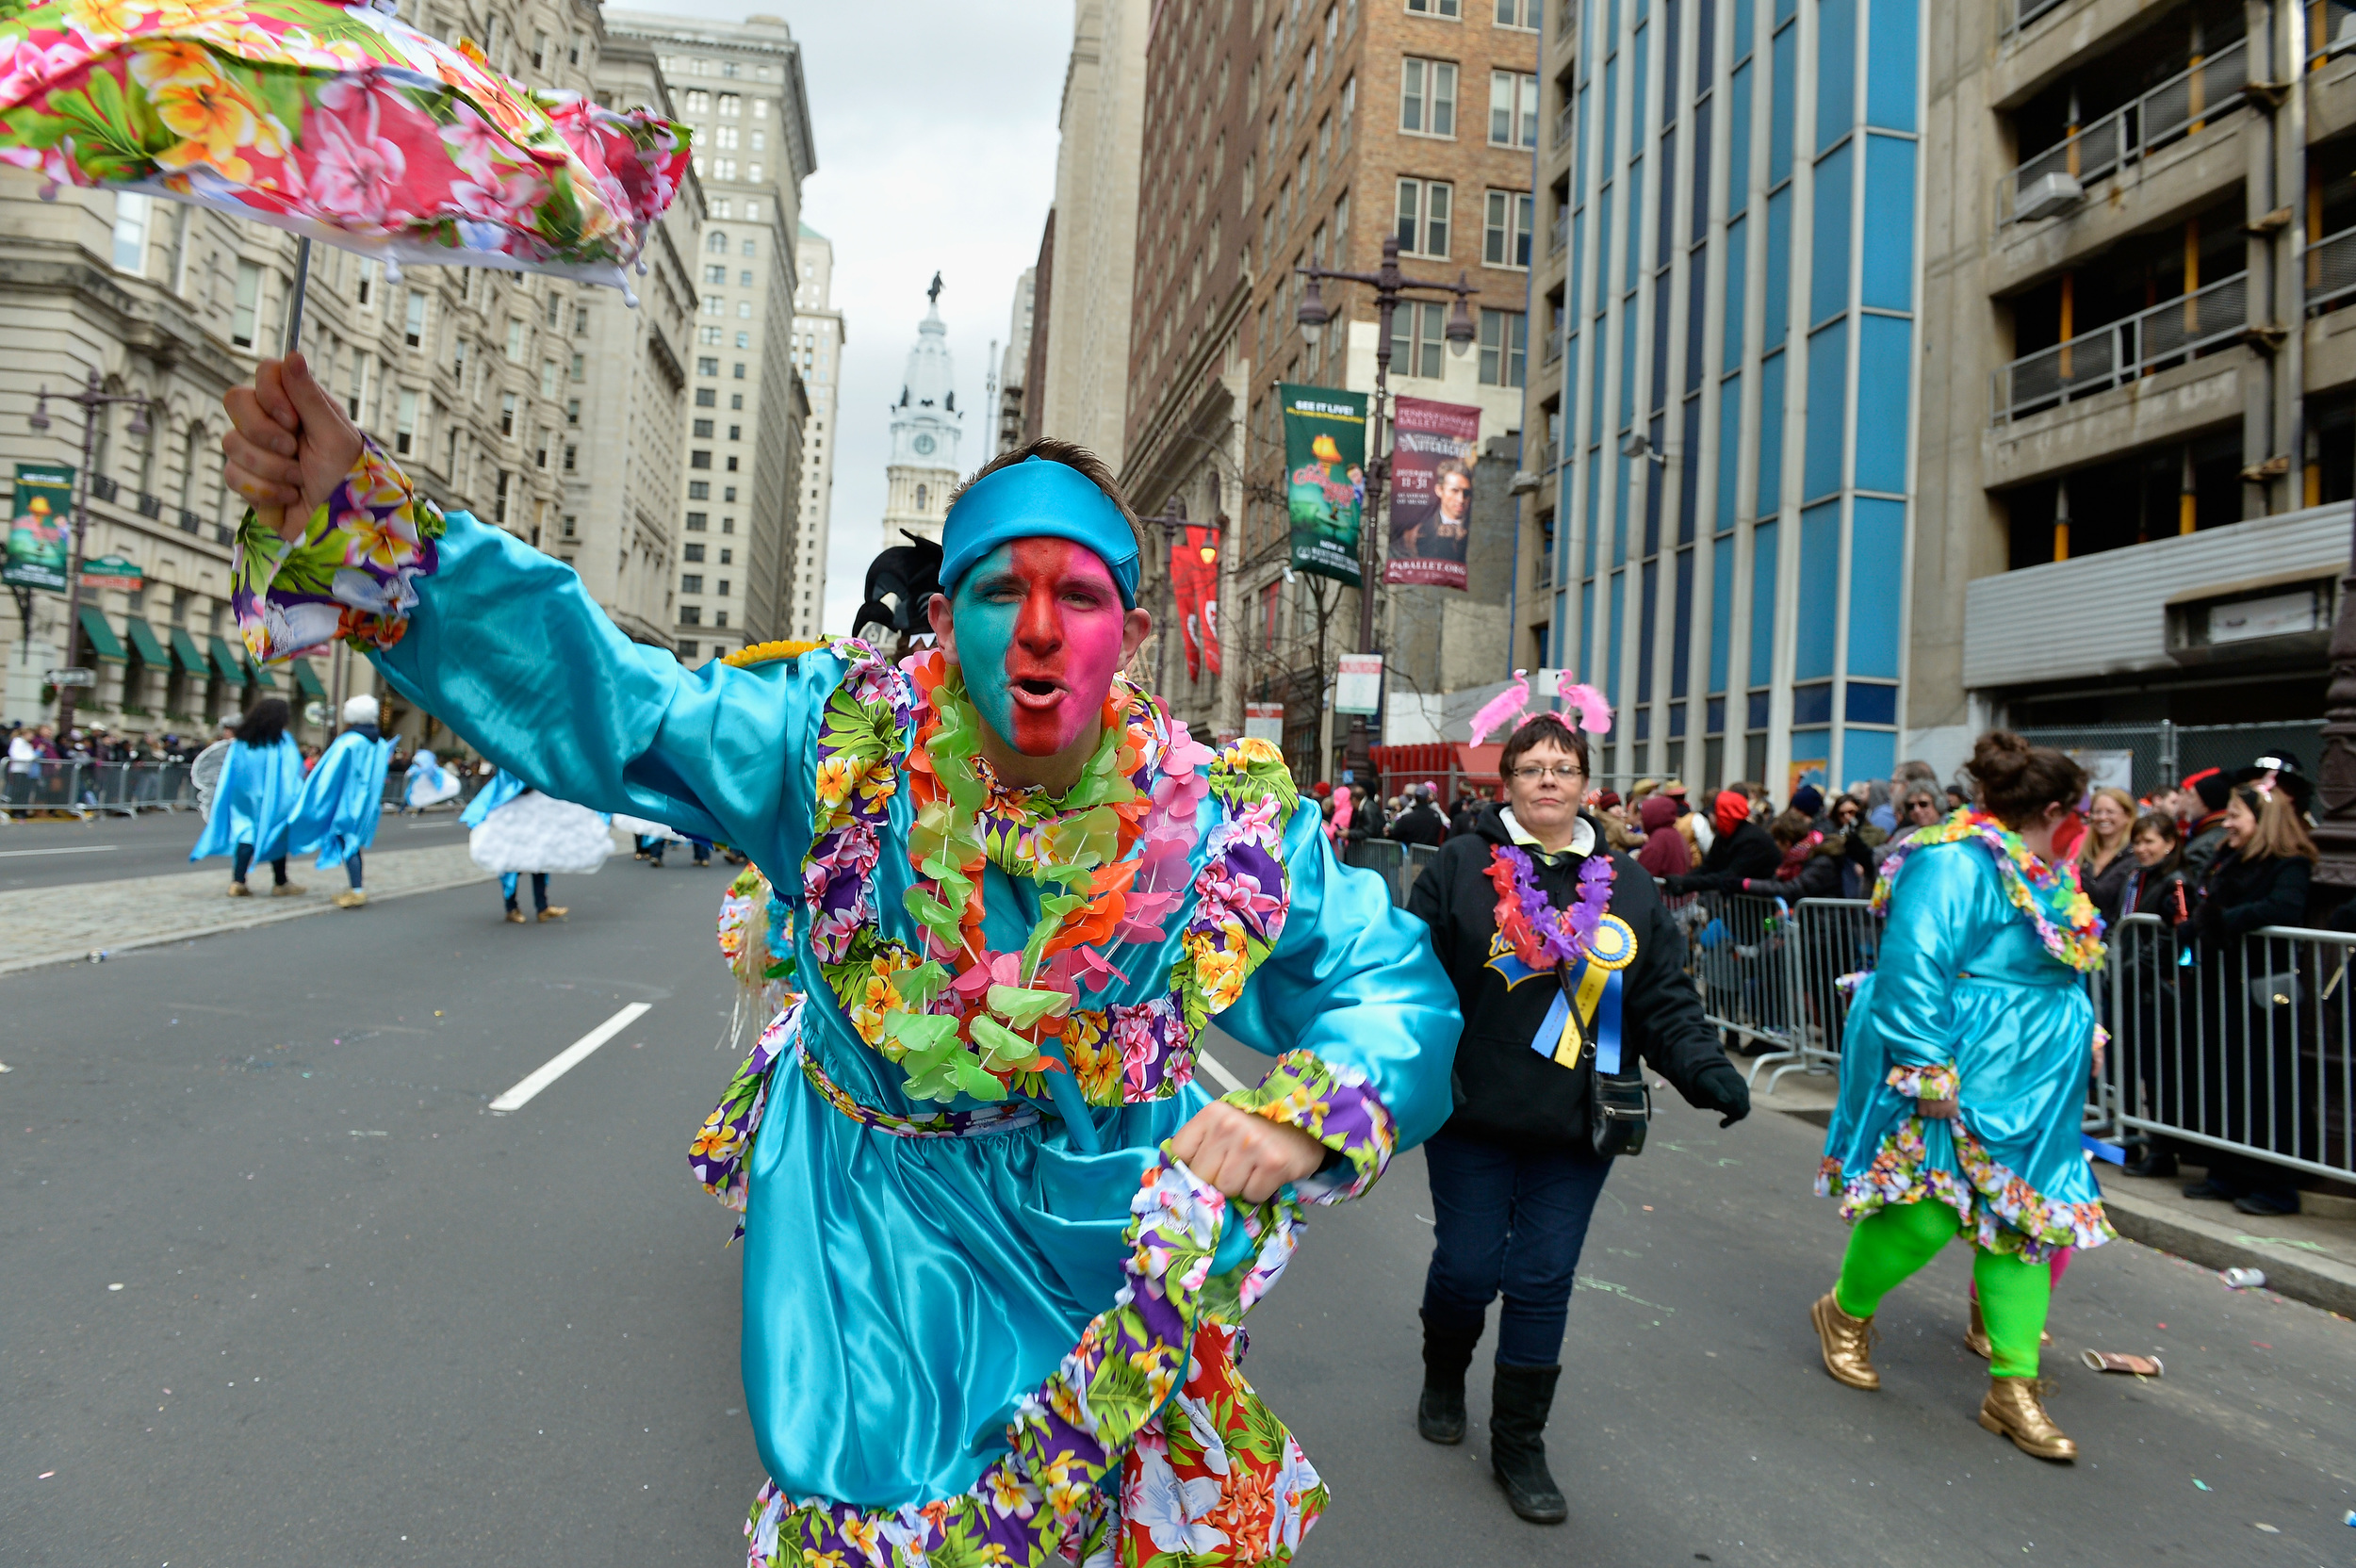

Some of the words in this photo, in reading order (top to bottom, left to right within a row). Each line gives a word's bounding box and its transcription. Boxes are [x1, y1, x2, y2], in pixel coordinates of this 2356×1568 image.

[1295, 400, 1316, 412] SEE
[1316, 401, 1327, 413] IT
[1398, 416, 1438, 429] BALLET
